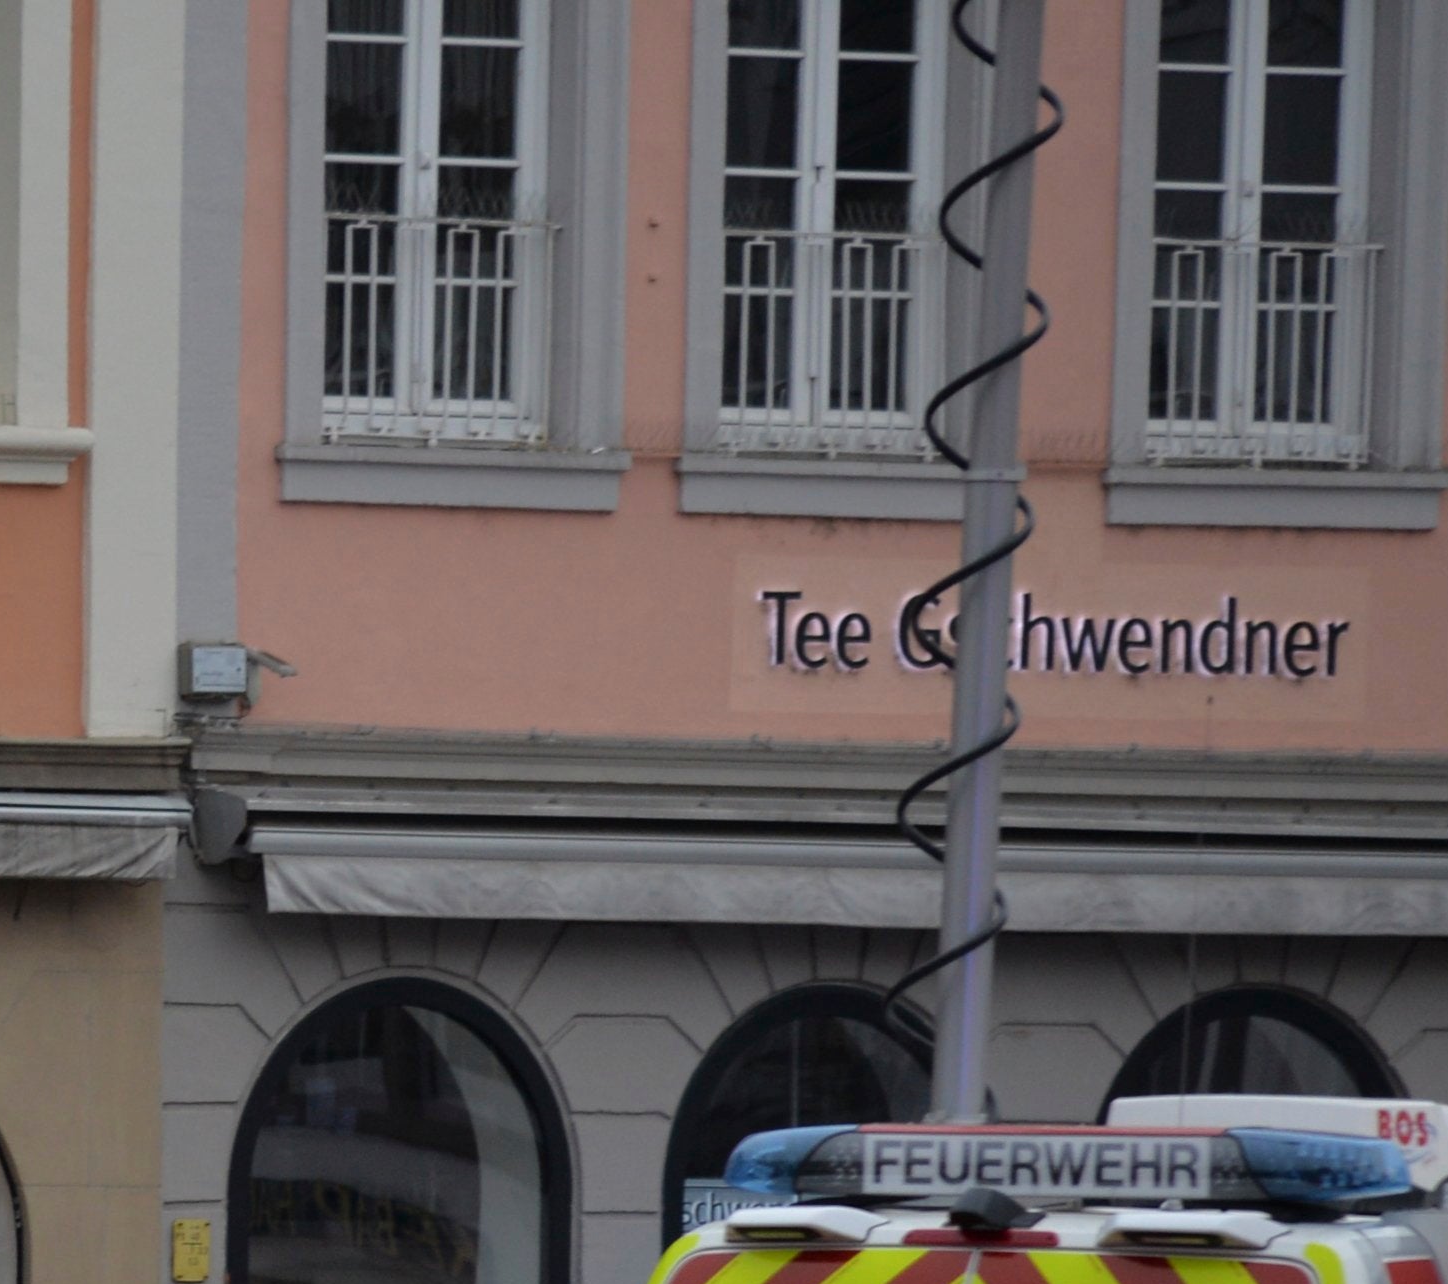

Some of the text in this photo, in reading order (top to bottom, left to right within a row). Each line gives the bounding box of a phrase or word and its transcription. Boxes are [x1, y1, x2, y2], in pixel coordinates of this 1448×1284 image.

[761, 589, 1350, 678] Tee Ghwendner
[1376, 1108, 1429, 1147] BOS
[872, 1138, 1202, 1190] FEUERWEHR
